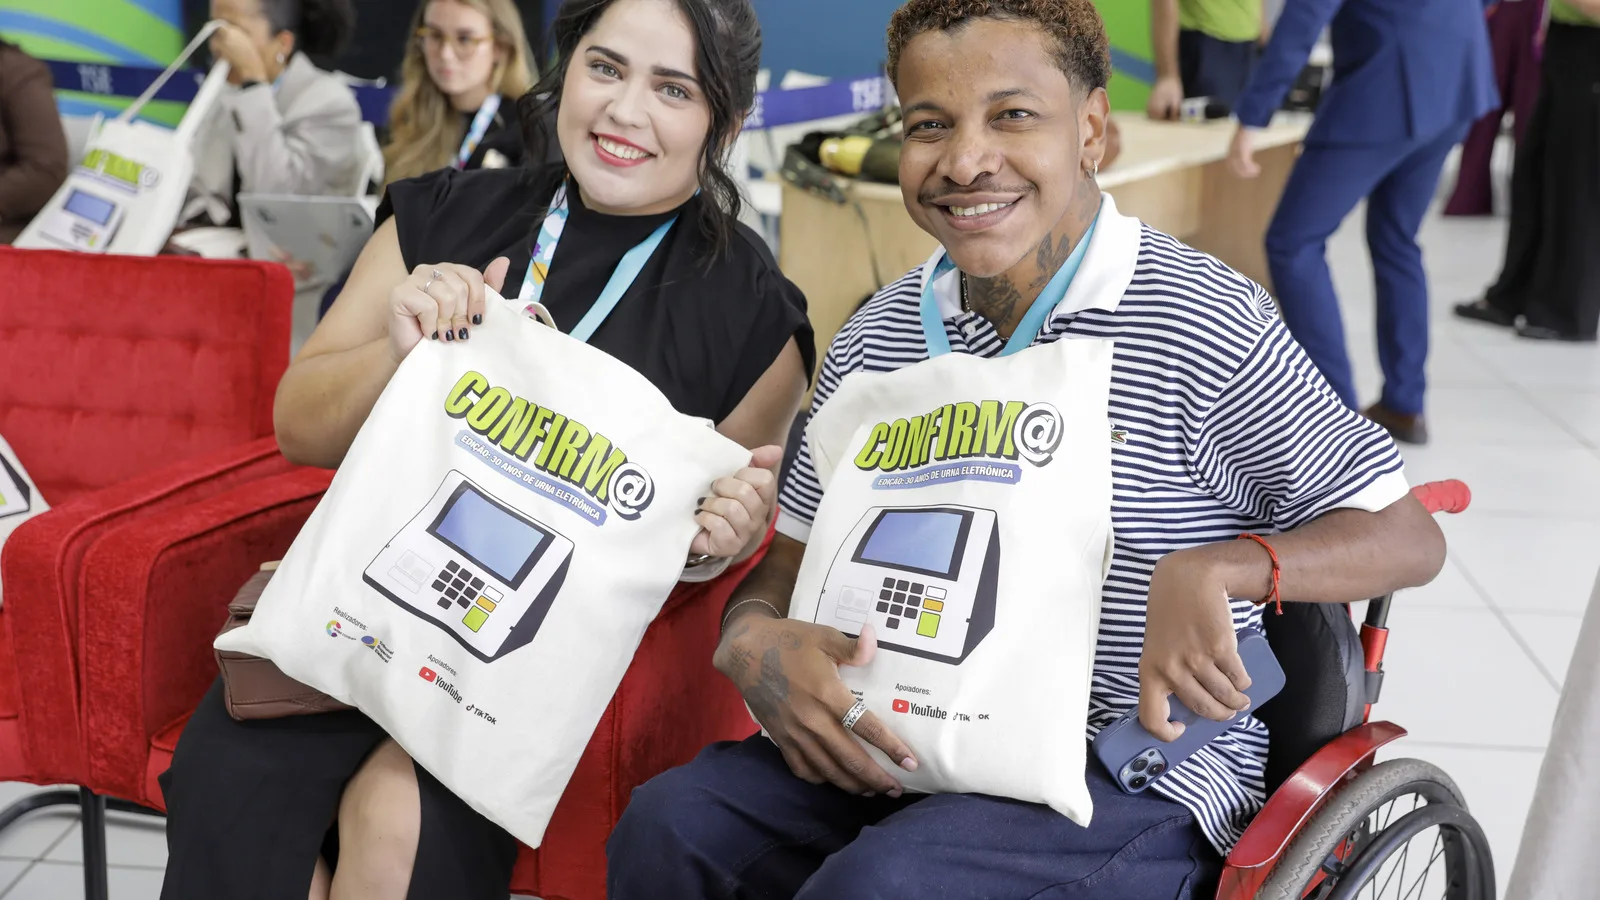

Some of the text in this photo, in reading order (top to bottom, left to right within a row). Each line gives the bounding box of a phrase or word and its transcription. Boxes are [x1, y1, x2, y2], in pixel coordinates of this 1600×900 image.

[444, 370, 655, 521] CONFIRM@
[854, 400, 1064, 472] CONFIRM@
[461, 435, 600, 521] EDIÇÃO: 30 ANOS DE URNA ELETRÔNICA
[878, 464, 1014, 487] EDIÇÃO: 30 ANOS DE URNA ELETRÔNICA
[333, 606, 368, 631] Realizadores:
[427, 654, 458, 677] Apoiadores:
[435, 675, 463, 704] YouTube
[895, 683, 931, 696] Apoiadores:
[473, 707, 497, 725] TikTok
[910, 702, 947, 720] YouTube
